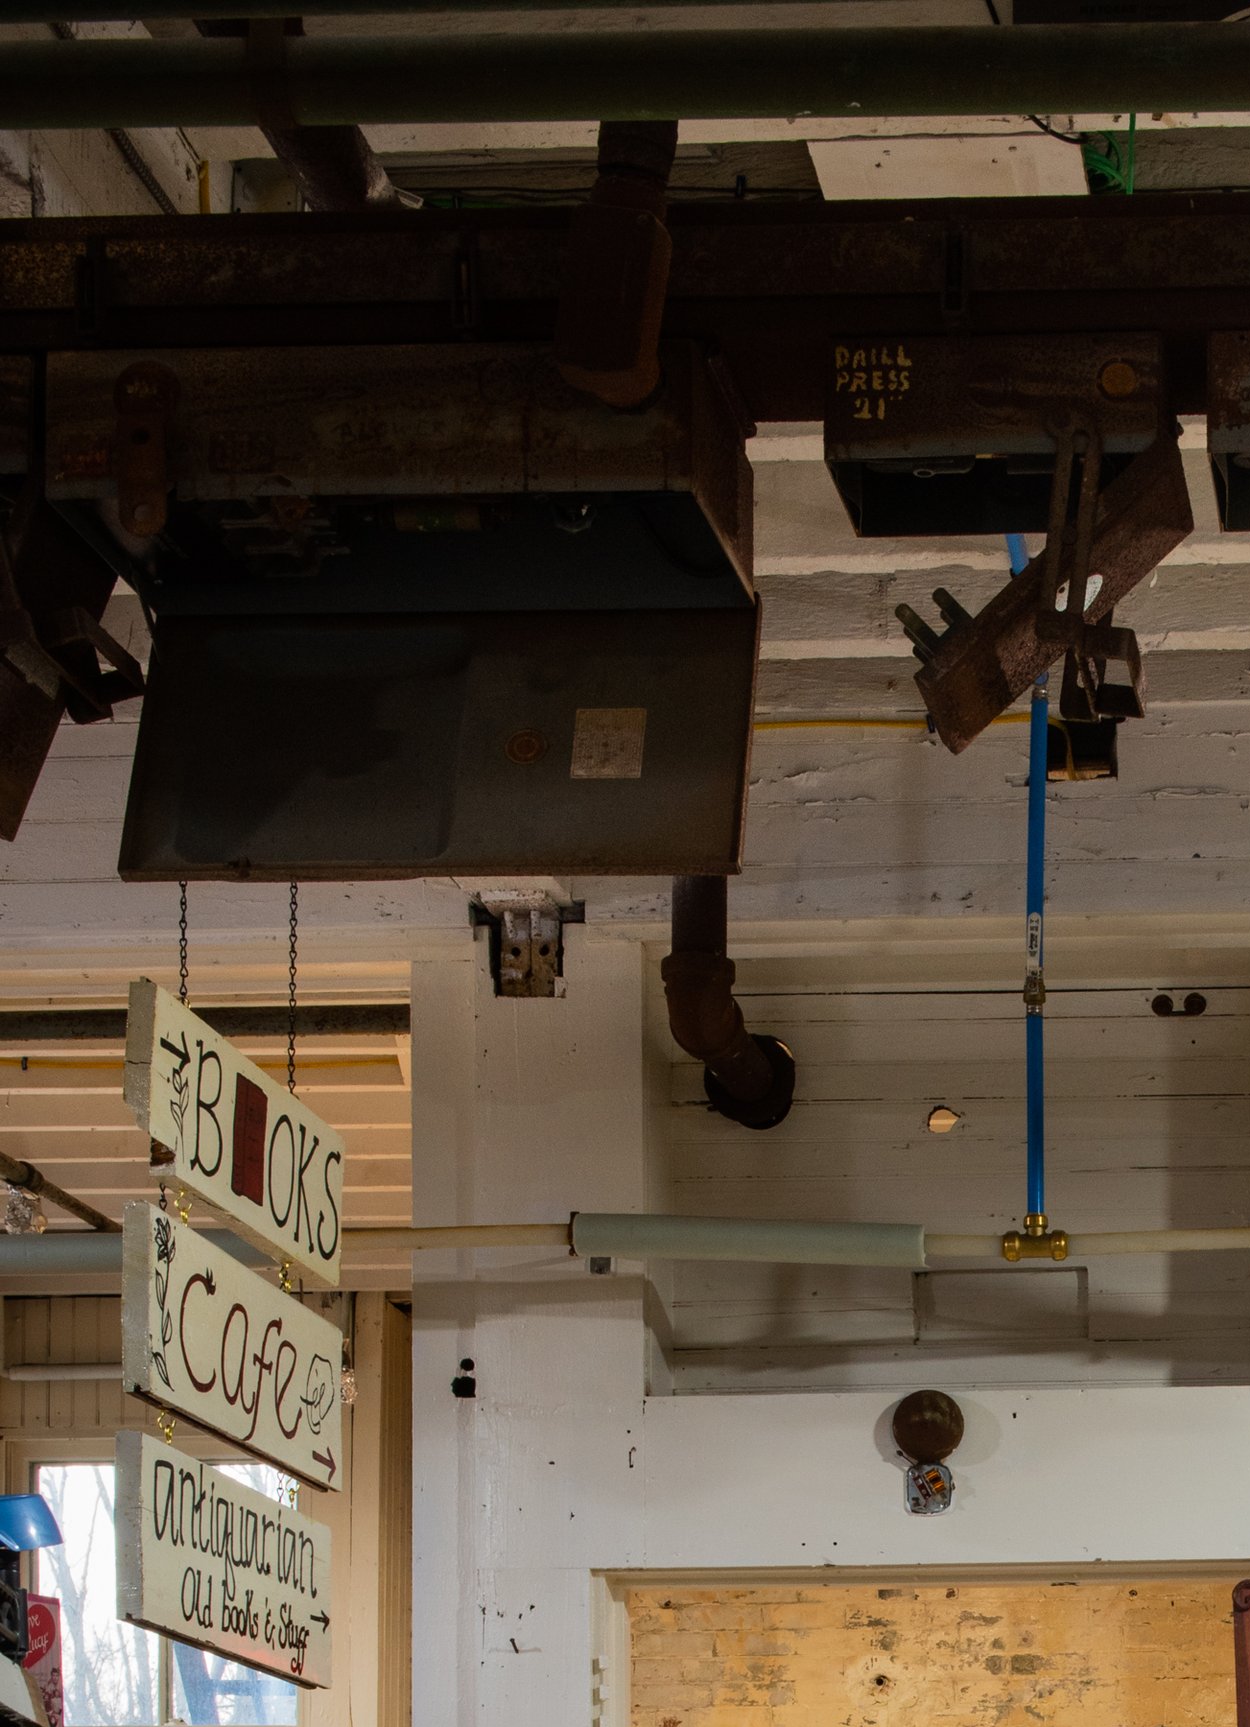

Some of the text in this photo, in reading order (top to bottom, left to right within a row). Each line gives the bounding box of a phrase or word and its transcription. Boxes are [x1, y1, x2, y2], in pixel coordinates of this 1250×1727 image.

[834, 370, 911, 392] PRESS
[181, 1564, 214, 1630] Old
[279, 1600, 310, 1676] Stuff
